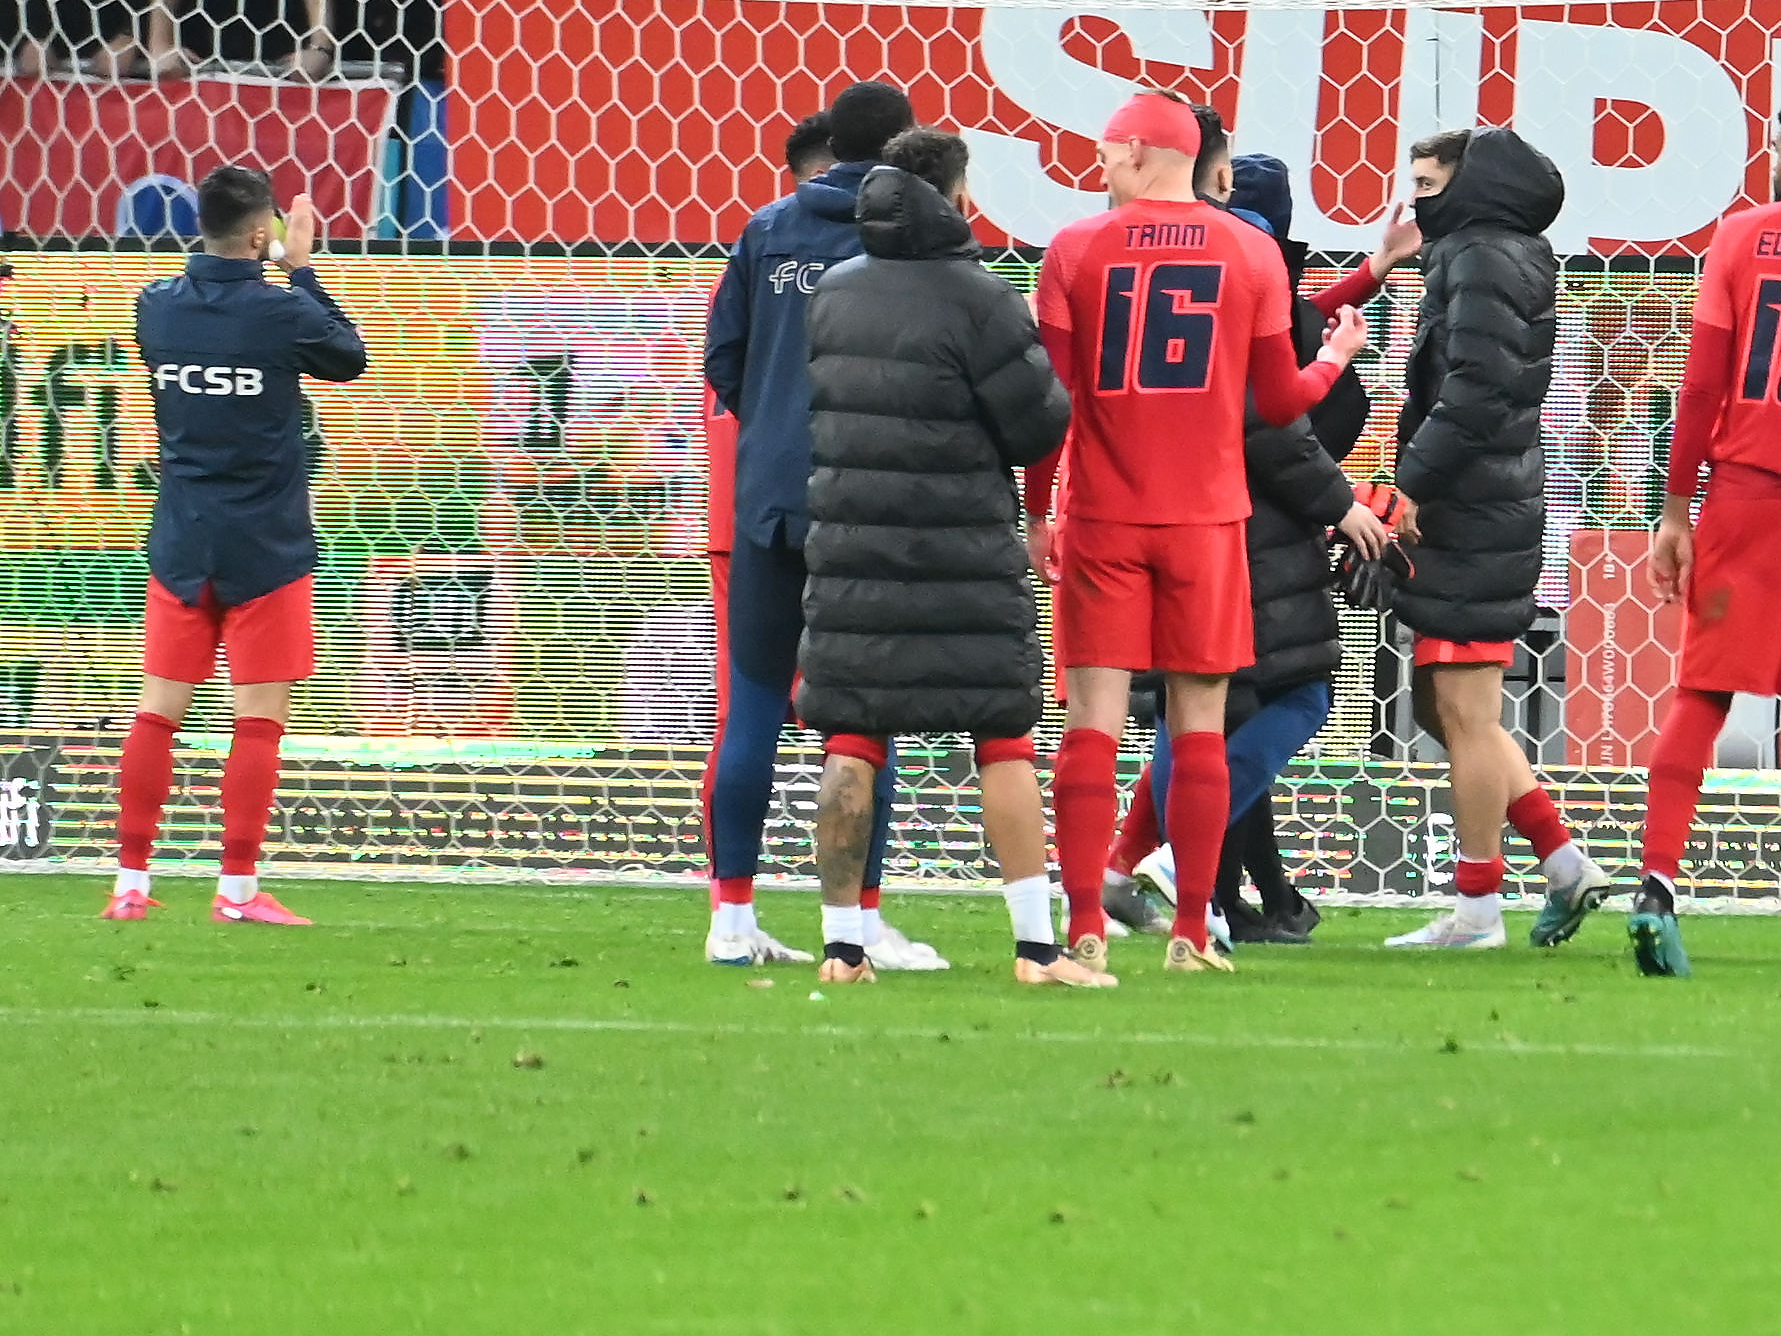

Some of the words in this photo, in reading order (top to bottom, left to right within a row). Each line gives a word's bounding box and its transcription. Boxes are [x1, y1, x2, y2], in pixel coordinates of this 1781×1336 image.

[1126, 223, 1205, 248] TAMM
[1098, 265, 1223, 390] 16
[153, 363, 264, 397] FCSB
